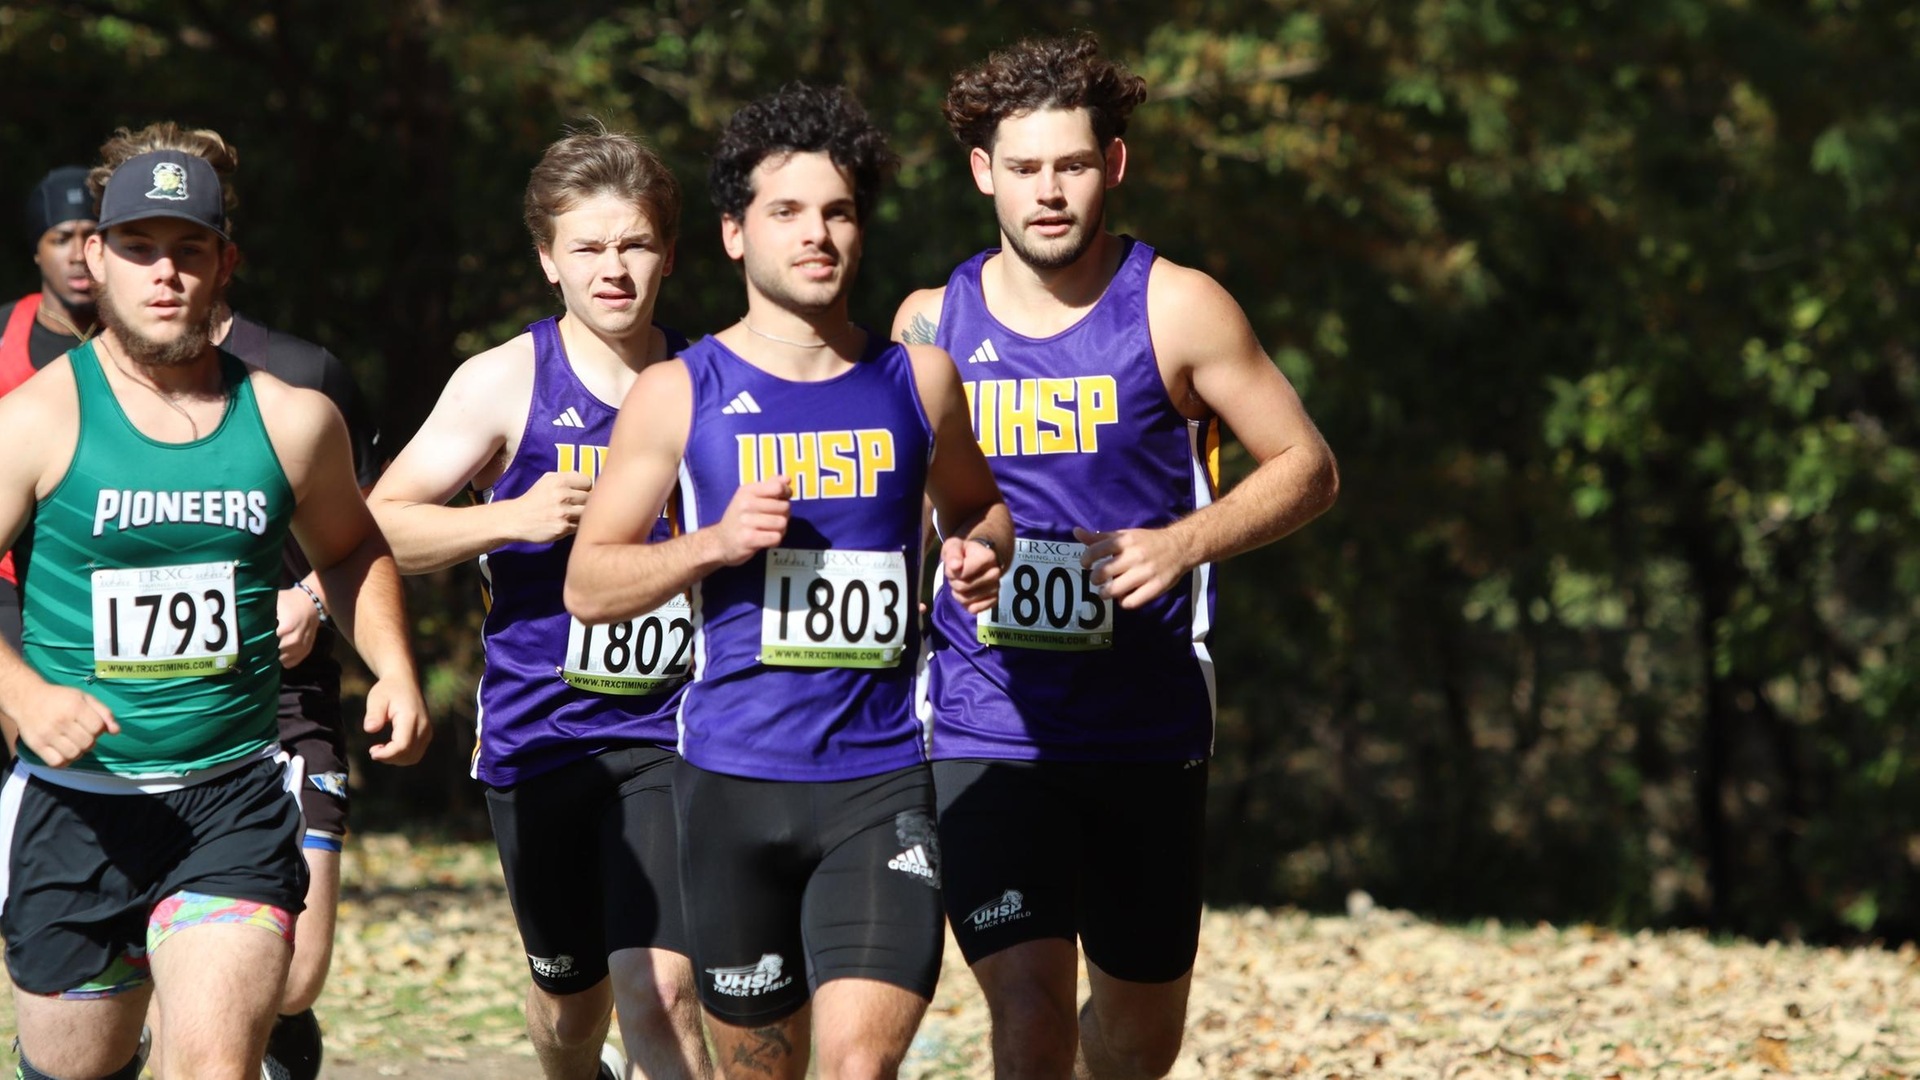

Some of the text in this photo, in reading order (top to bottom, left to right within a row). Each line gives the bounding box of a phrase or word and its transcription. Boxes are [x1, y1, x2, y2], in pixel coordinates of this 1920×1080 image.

[735, 428, 896, 500] UHSP
[92, 489, 268, 537] PIONEERS
[1016, 540, 1070, 556] TRXC
[809, 552, 871, 567] TRXC
[136, 567, 193, 583] TRXC
[991, 564, 1106, 629] 805
[780, 576, 899, 644] 1803
[108, 589, 228, 656] 1793
[580, 616, 694, 675] 1802
[988, 631, 1088, 645] WWW.TRXCTIMING.COM
[774, 650, 880, 661] WWW.TRXCTIMING.COM
[108, 660, 213, 673] WWW.TRXCTIMING.COM
[888, 858, 934, 878] adidas
[974, 904, 1022, 925] UHSP
[974, 920, 998, 932] TRACK
[1008, 911, 1031, 922] FIELD
[533, 959, 571, 974] UHSP
[713, 976, 792, 997] TRACK & FIELD
[714, 971, 782, 989] UHSP
